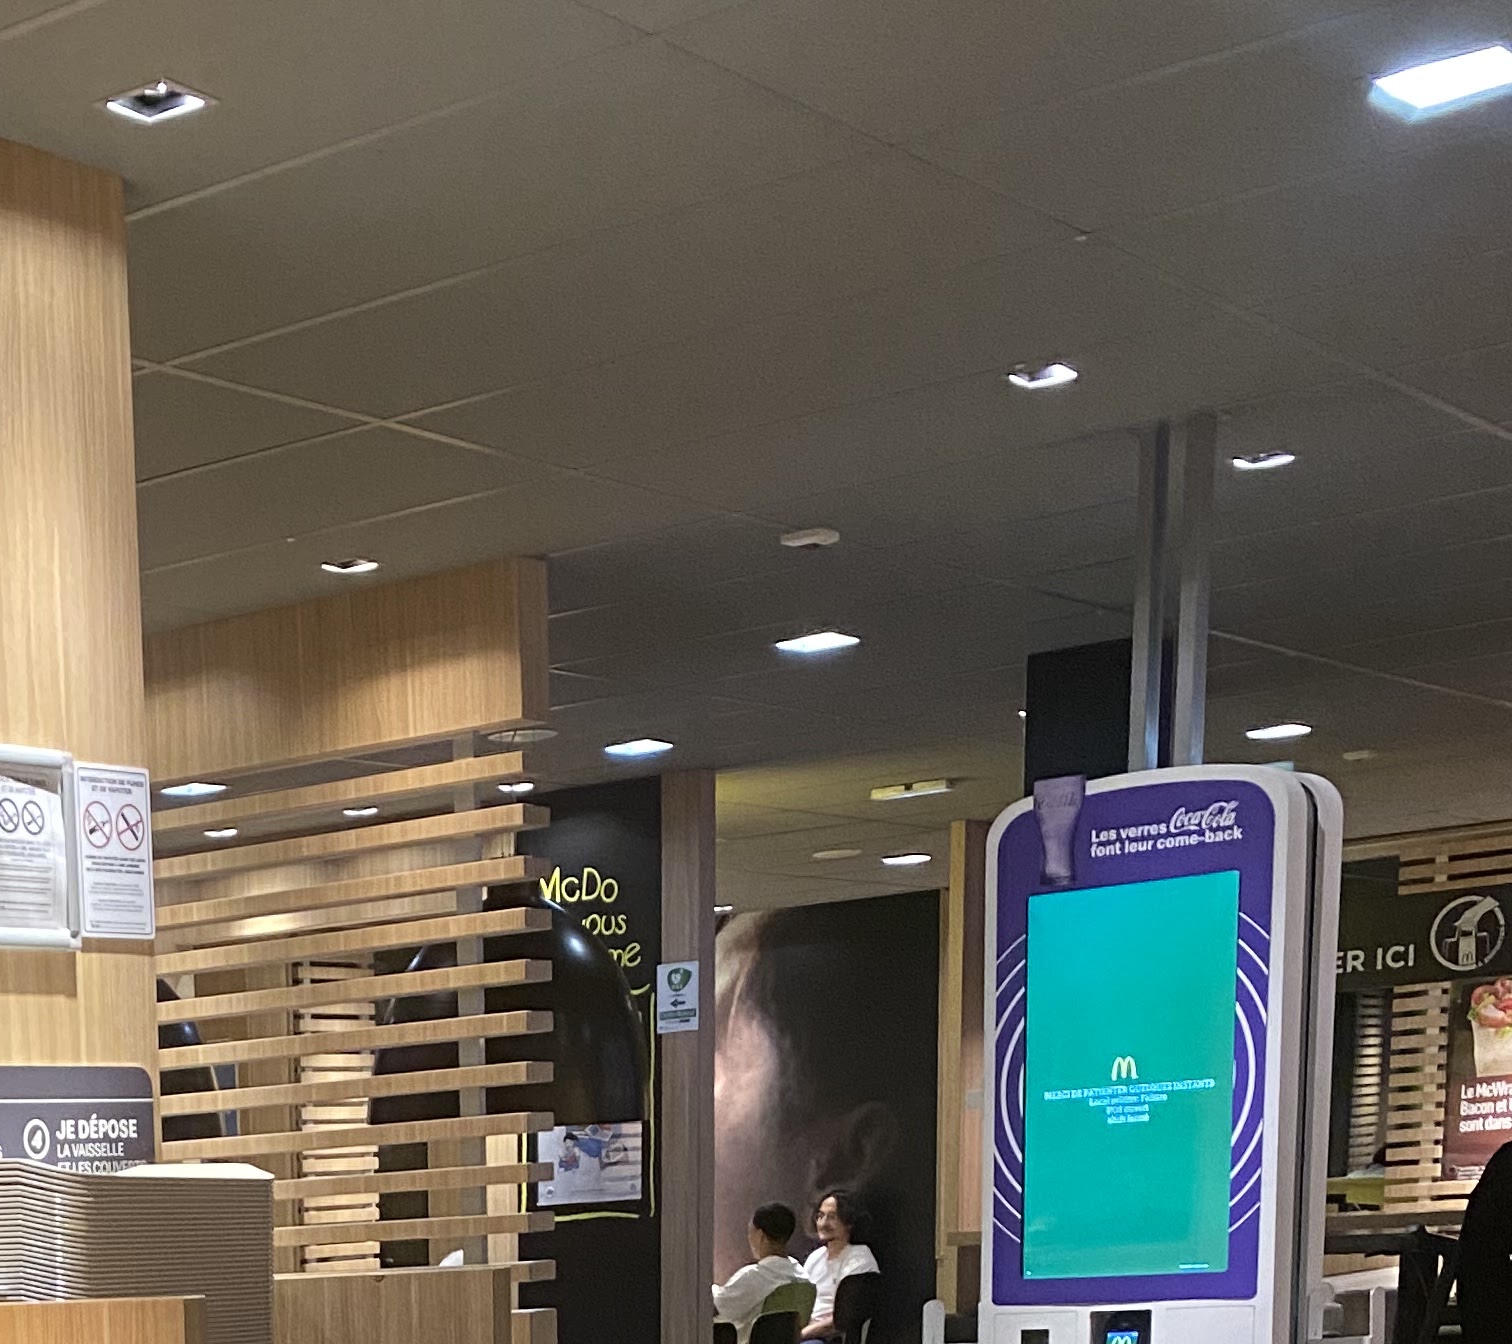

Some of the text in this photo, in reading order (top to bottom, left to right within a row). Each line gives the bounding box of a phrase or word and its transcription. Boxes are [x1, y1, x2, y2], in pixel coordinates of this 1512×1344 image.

[1090, 825, 1243, 858] font leur come-back
[1091, 829, 1117, 843] Les
[1119, 823, 1168, 839] verres
[582, 913, 627, 935] ous
[1376, 943, 1415, 970] ICI
[1460, 1099, 1494, 1116] Bacon
[56, 1114, 137, 1139] JE DÉPOSE
[31, 1130, 43, 1149] 4
[57, 1142, 124, 1158] LA VAISSELLE
